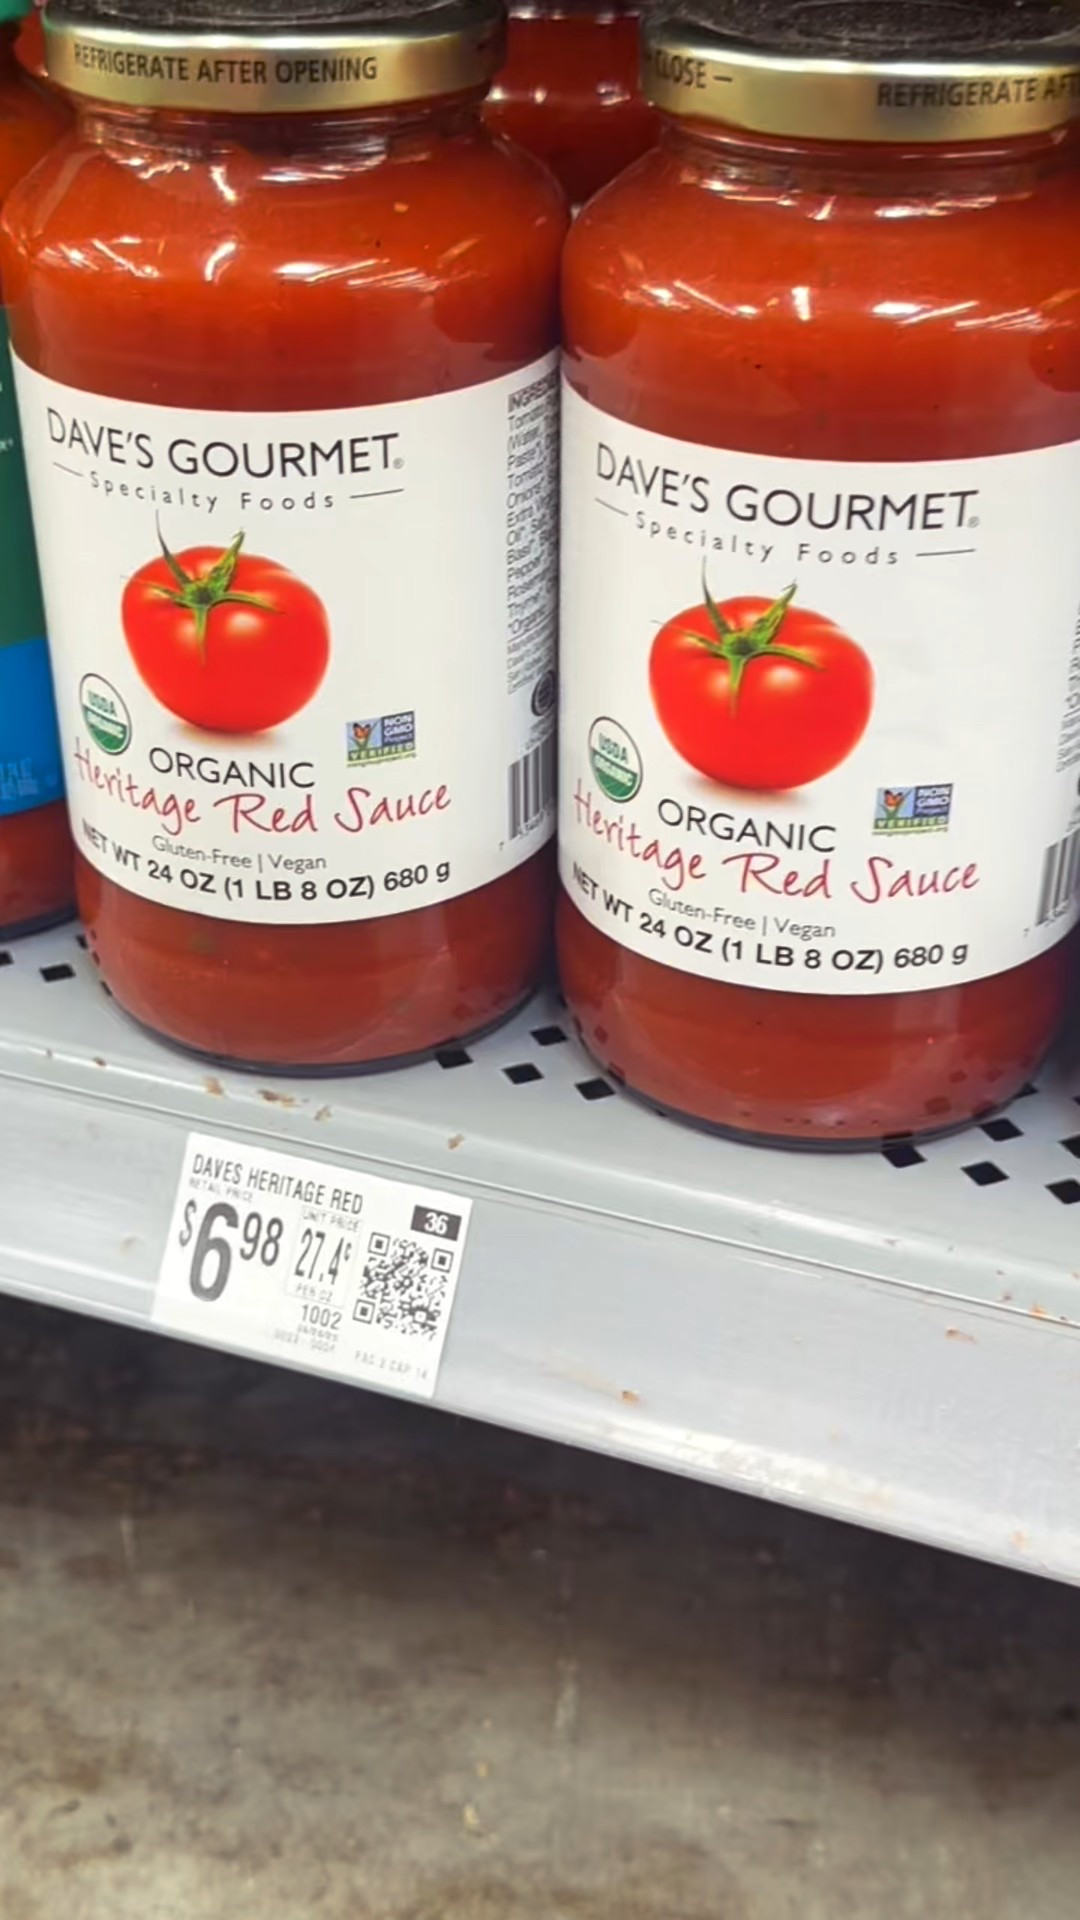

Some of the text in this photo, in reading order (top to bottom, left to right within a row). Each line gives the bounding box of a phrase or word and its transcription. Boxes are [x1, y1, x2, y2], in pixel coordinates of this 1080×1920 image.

[74, 43, 378, 84] REFRIGERATE AFTER OPENING
[655, 49, 706, 89] CLOSE
[876, 77, 1037, 108] REFRIGERATE
[47, 407, 154, 469] DAVE'S
[90, 470, 334, 512] Specialty Foods
[597, 442, 710, 514] DAVE'S
[635, 511, 898, 564] Specialty Foods
[383, 713, 413, 728] NON
[383, 723, 413, 737] GMO
[149, 747, 316, 789] ORGANIC
[598, 732, 628, 764] USDA
[74, 736, 201, 836] Heritage
[213, 792, 318, 834] Red
[334, 783, 452, 833] Sauce
[574, 778, 707, 892] Heritage
[722, 852, 832, 899] Red
[851, 856, 980, 903] Sauce
[658, 798, 837, 853] ORGANIC
[82, 818, 452, 902] NET WT 24 OZ (1 LB 8 OZ) 680 g
[152, 834, 327, 875] Gluten-Free Vegan
[573, 860, 969, 975] NET WT 24 OZ (1 LB 8 OZ) 680 g
[648, 888, 836, 940] Gluten-Free Vegan
[188, 1177, 254, 1204] RETAIL PRICE
[192, 1153, 363, 1215] DAVES HERITAGE RED
[302, 1209, 360, 1233] UNIT PRICE
[424, 1211, 449, 1235] 36
[301, 1303, 342, 1330] 1002
